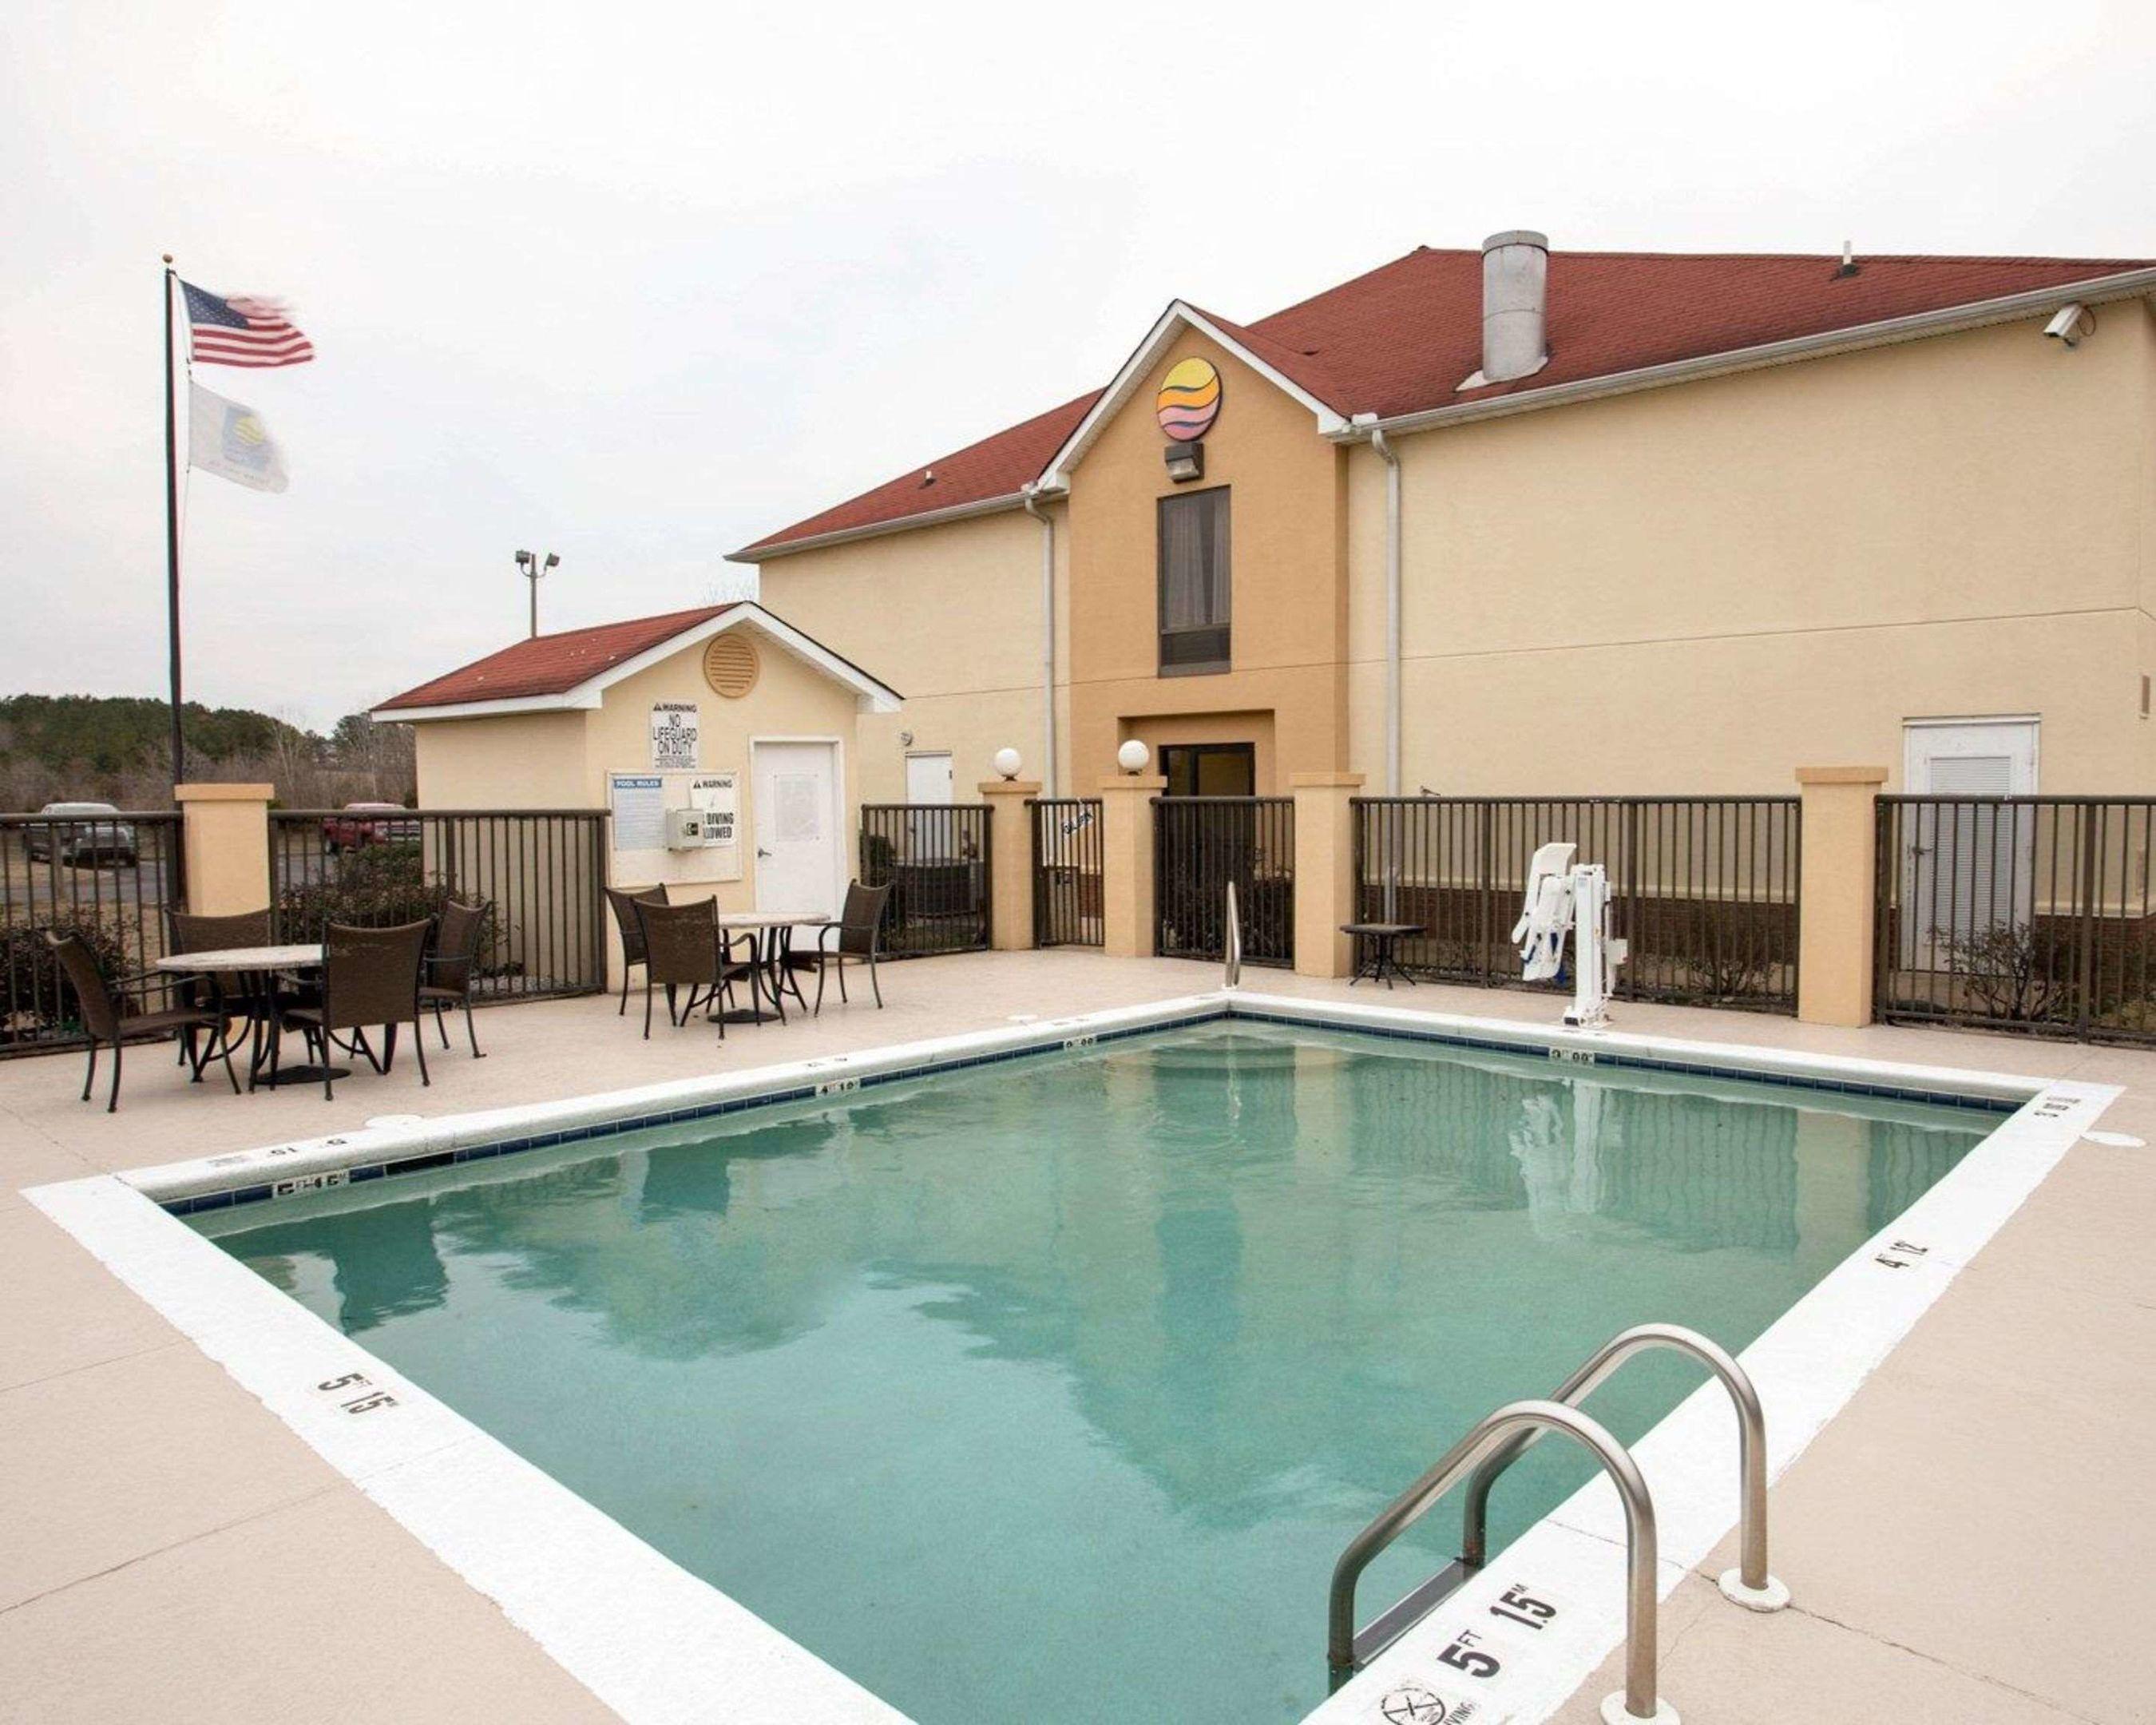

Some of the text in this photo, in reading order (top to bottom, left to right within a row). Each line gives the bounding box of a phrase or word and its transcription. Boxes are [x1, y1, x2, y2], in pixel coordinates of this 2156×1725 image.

[663, 704, 697, 712] WARNING
[669, 714, 680, 727] NO
[652, 727, 697, 742] LIFEGUARD
[658, 741, 693, 754] ON DUTY
[703, 779, 732, 788] WARNING
[707, 812, 734, 825] DIVING
[1489, 1591, 1556, 1630] 1.5
[1456, 1629, 1482, 1647] FT
[1437, 1644, 1500, 1678] 5
